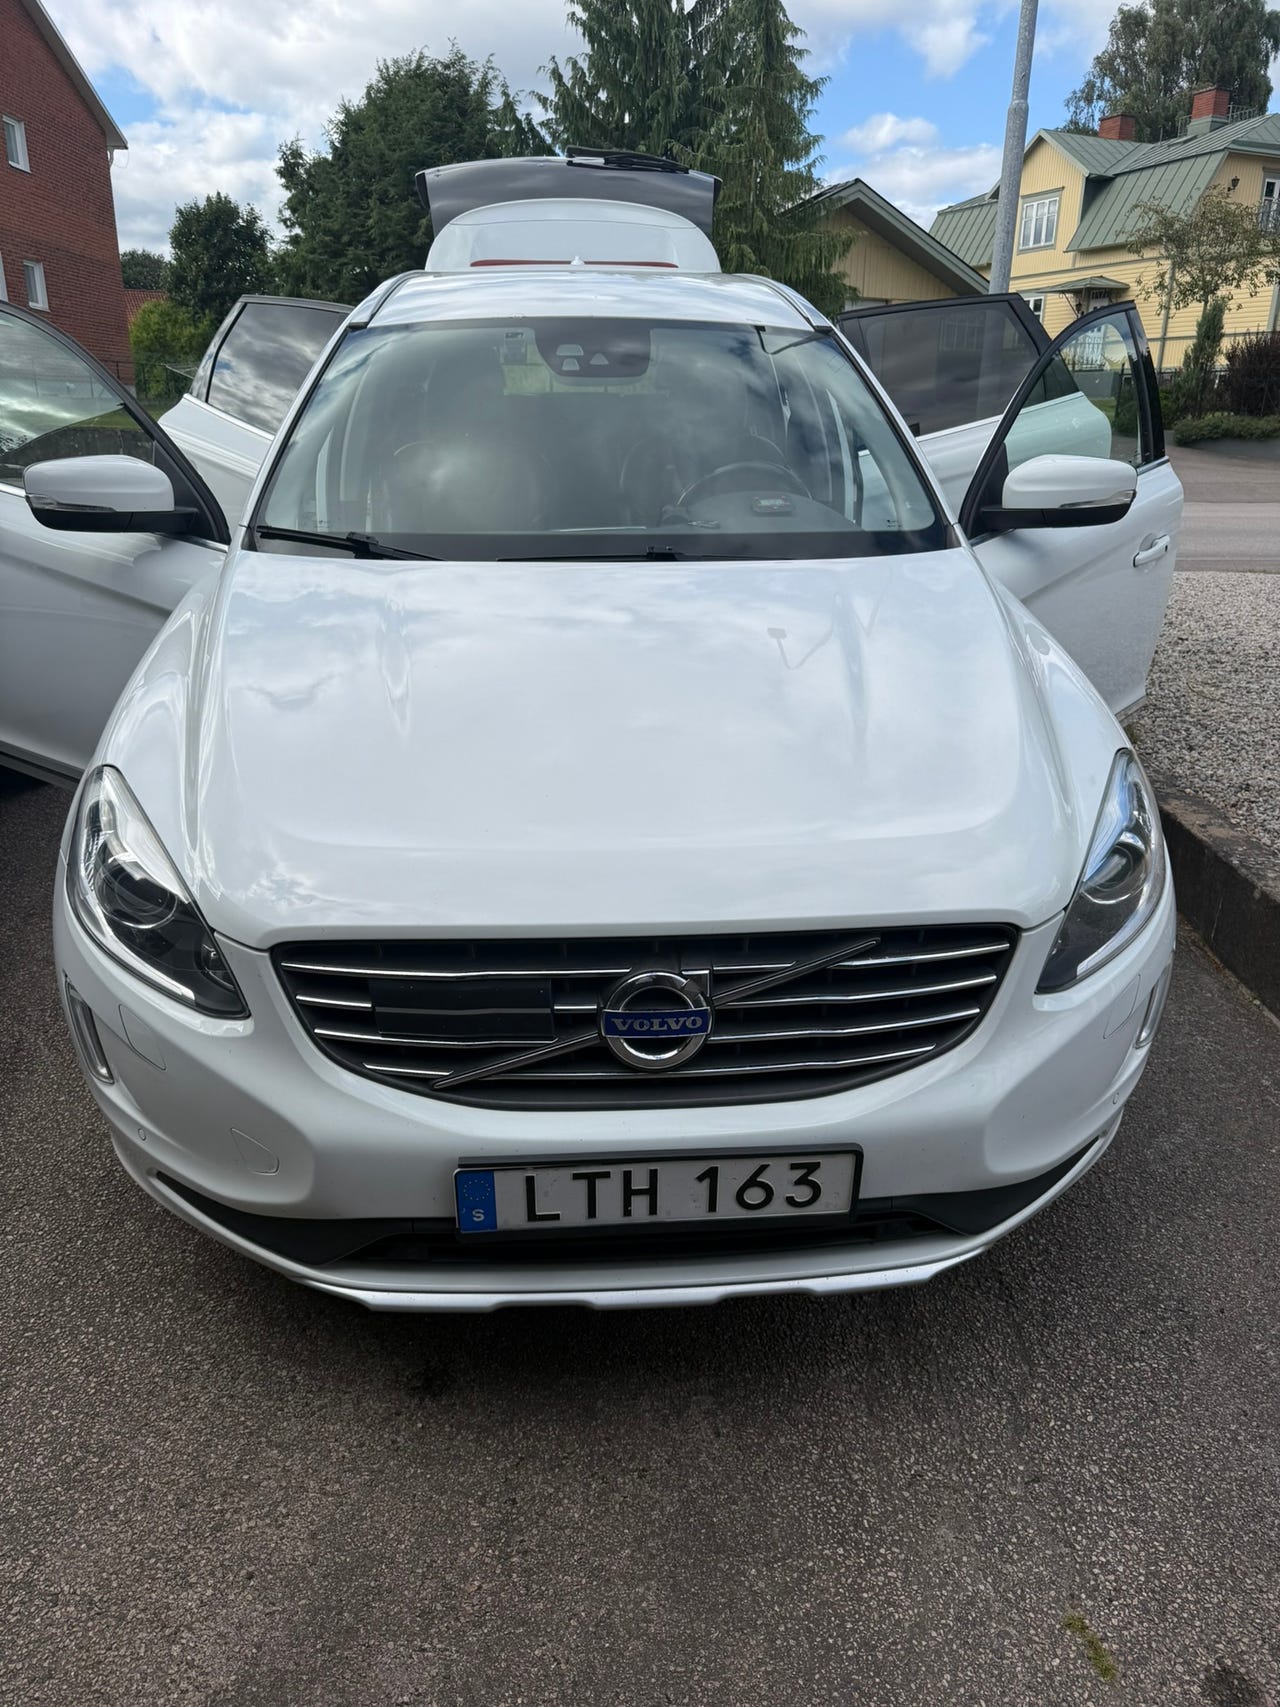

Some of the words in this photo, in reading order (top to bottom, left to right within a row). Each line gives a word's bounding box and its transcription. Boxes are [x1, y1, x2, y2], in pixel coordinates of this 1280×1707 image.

[611, 1016, 703, 1031] VOLVO
[524, 1168, 659, 1223] LTH
[695, 1161, 823, 1213] 163
[472, 1208, 485, 1222] S
